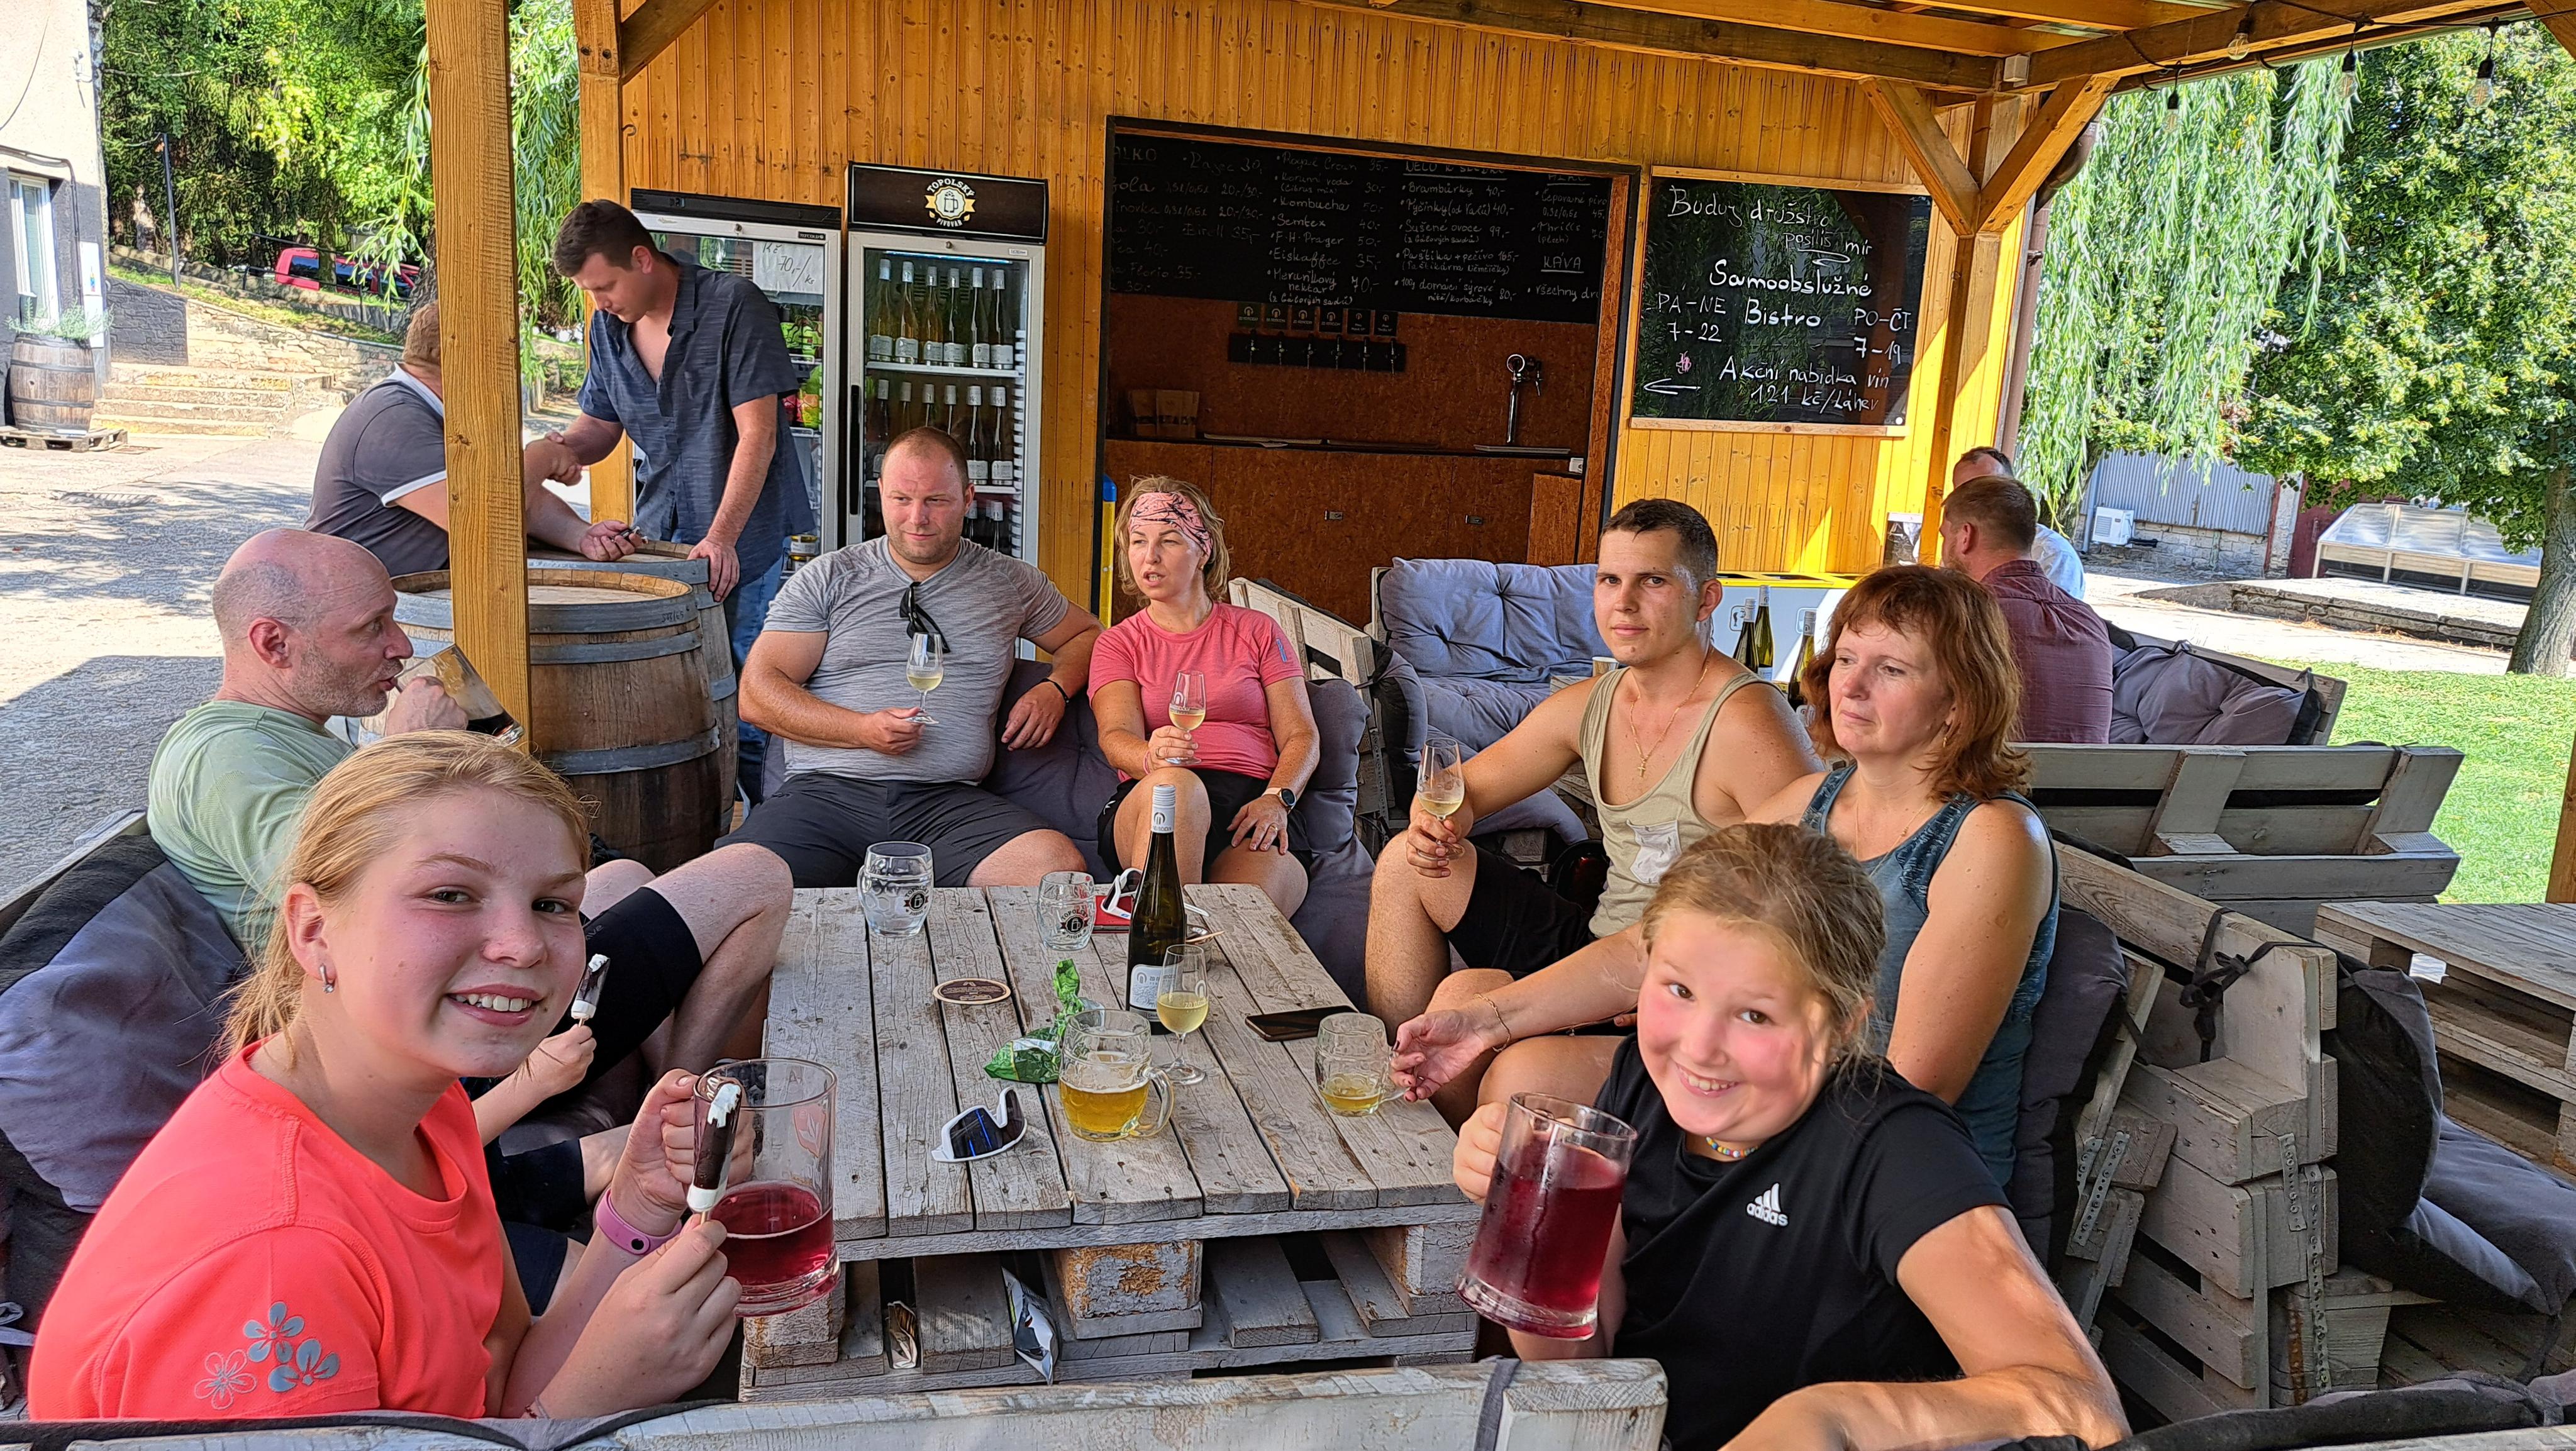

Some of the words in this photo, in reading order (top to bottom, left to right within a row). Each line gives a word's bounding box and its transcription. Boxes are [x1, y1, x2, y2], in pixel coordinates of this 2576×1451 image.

[1279, 196, 1350, 211] Kombucha
[1277, 213, 1326, 227] Semtex
[1451, 223, 1483, 233] ovoce
[1543, 251, 1582, 270] KÁVA
[1709, 259, 1872, 297] Samoobslužné
[1745, 296, 1821, 328] Bistro
[1719, 355, 1784, 381] Akční
[1750, 384, 1789, 404] 121
[1746, 1203, 1789, 1226] adidas
